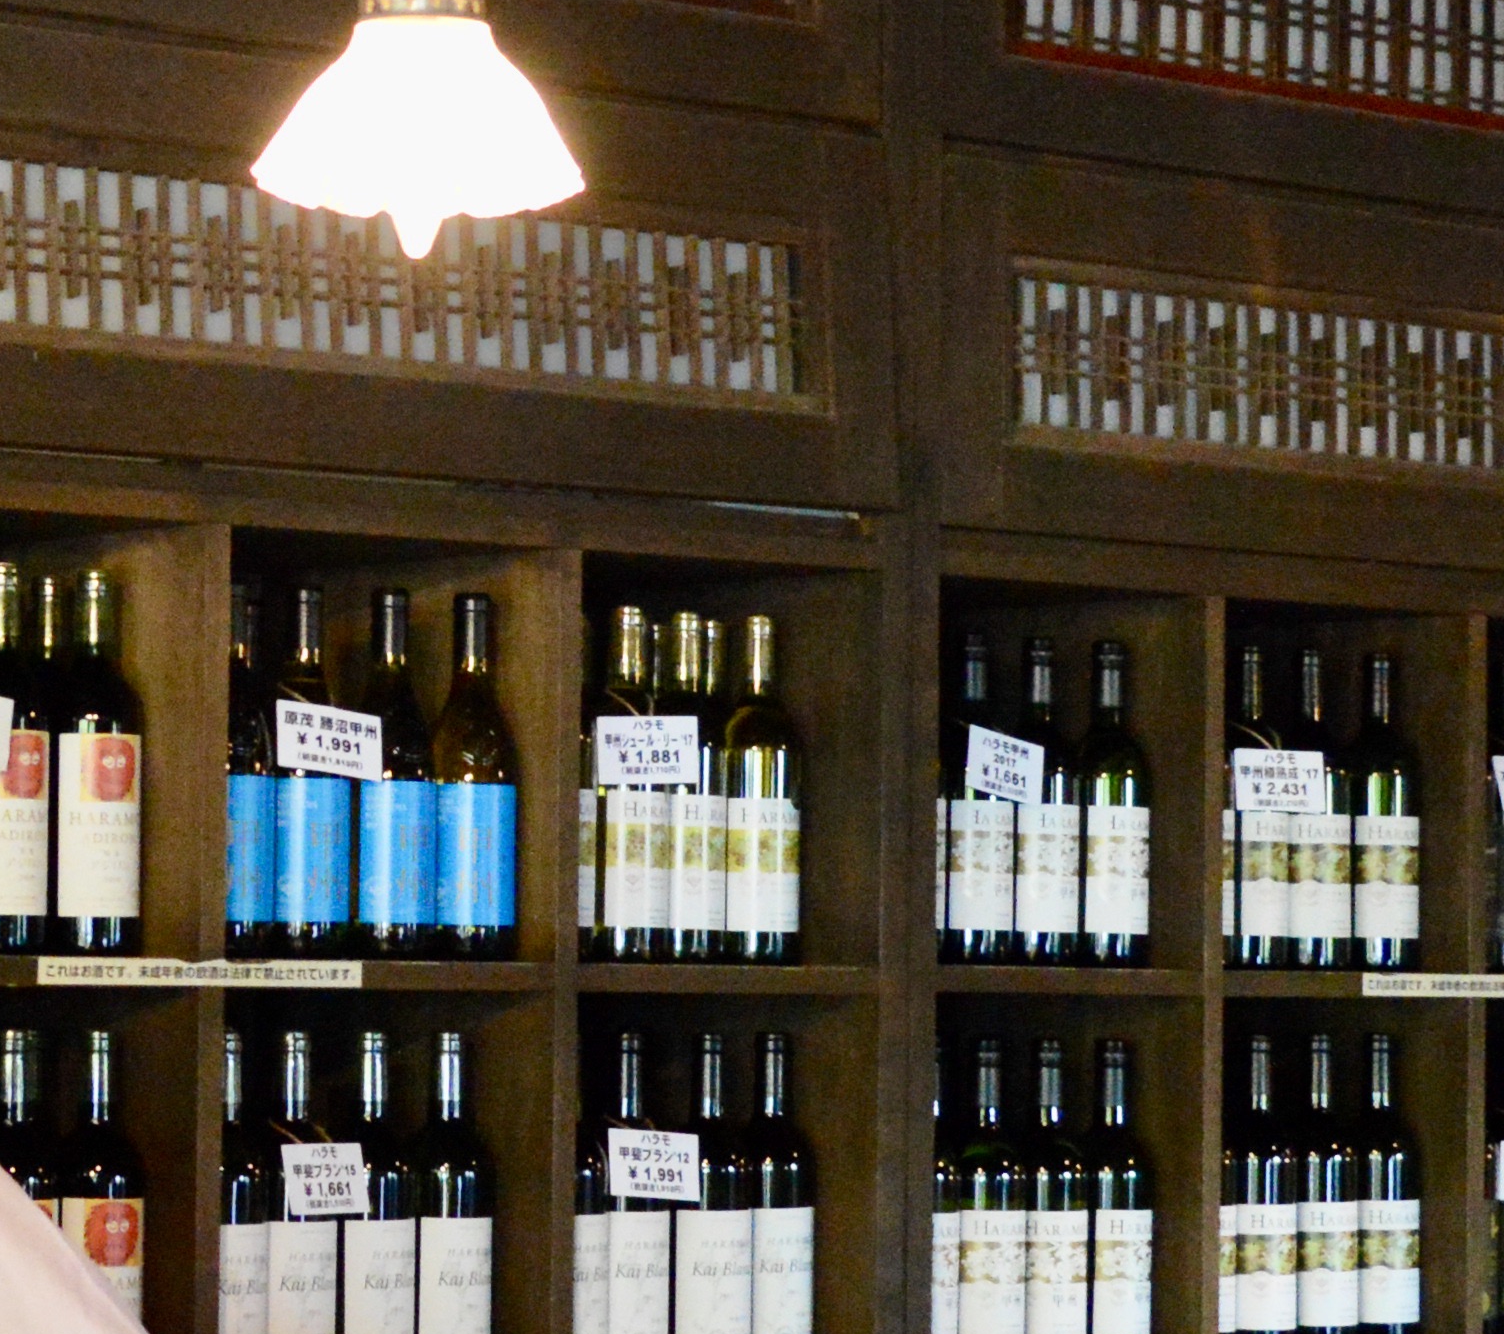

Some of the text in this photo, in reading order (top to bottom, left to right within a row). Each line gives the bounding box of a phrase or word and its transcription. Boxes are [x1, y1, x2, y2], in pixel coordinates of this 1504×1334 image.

[284, 711, 378, 740] 原茂 勝沼甲州
[633, 720, 664, 731] ハラモ
[315, 736, 361, 755] 1,991
[636, 751, 680, 764] 1,881
[994, 754, 1017, 767] 2017
[1264, 753, 1296, 764] ハラモ
[1267, 782, 1307, 797] 2,431
[641, 1133, 671, 1146] ハラモ
[311, 1146, 337, 1159] ハラモ
[644, 1166, 683, 1183] 1,991
[318, 1182, 352, 1198] 1,661
